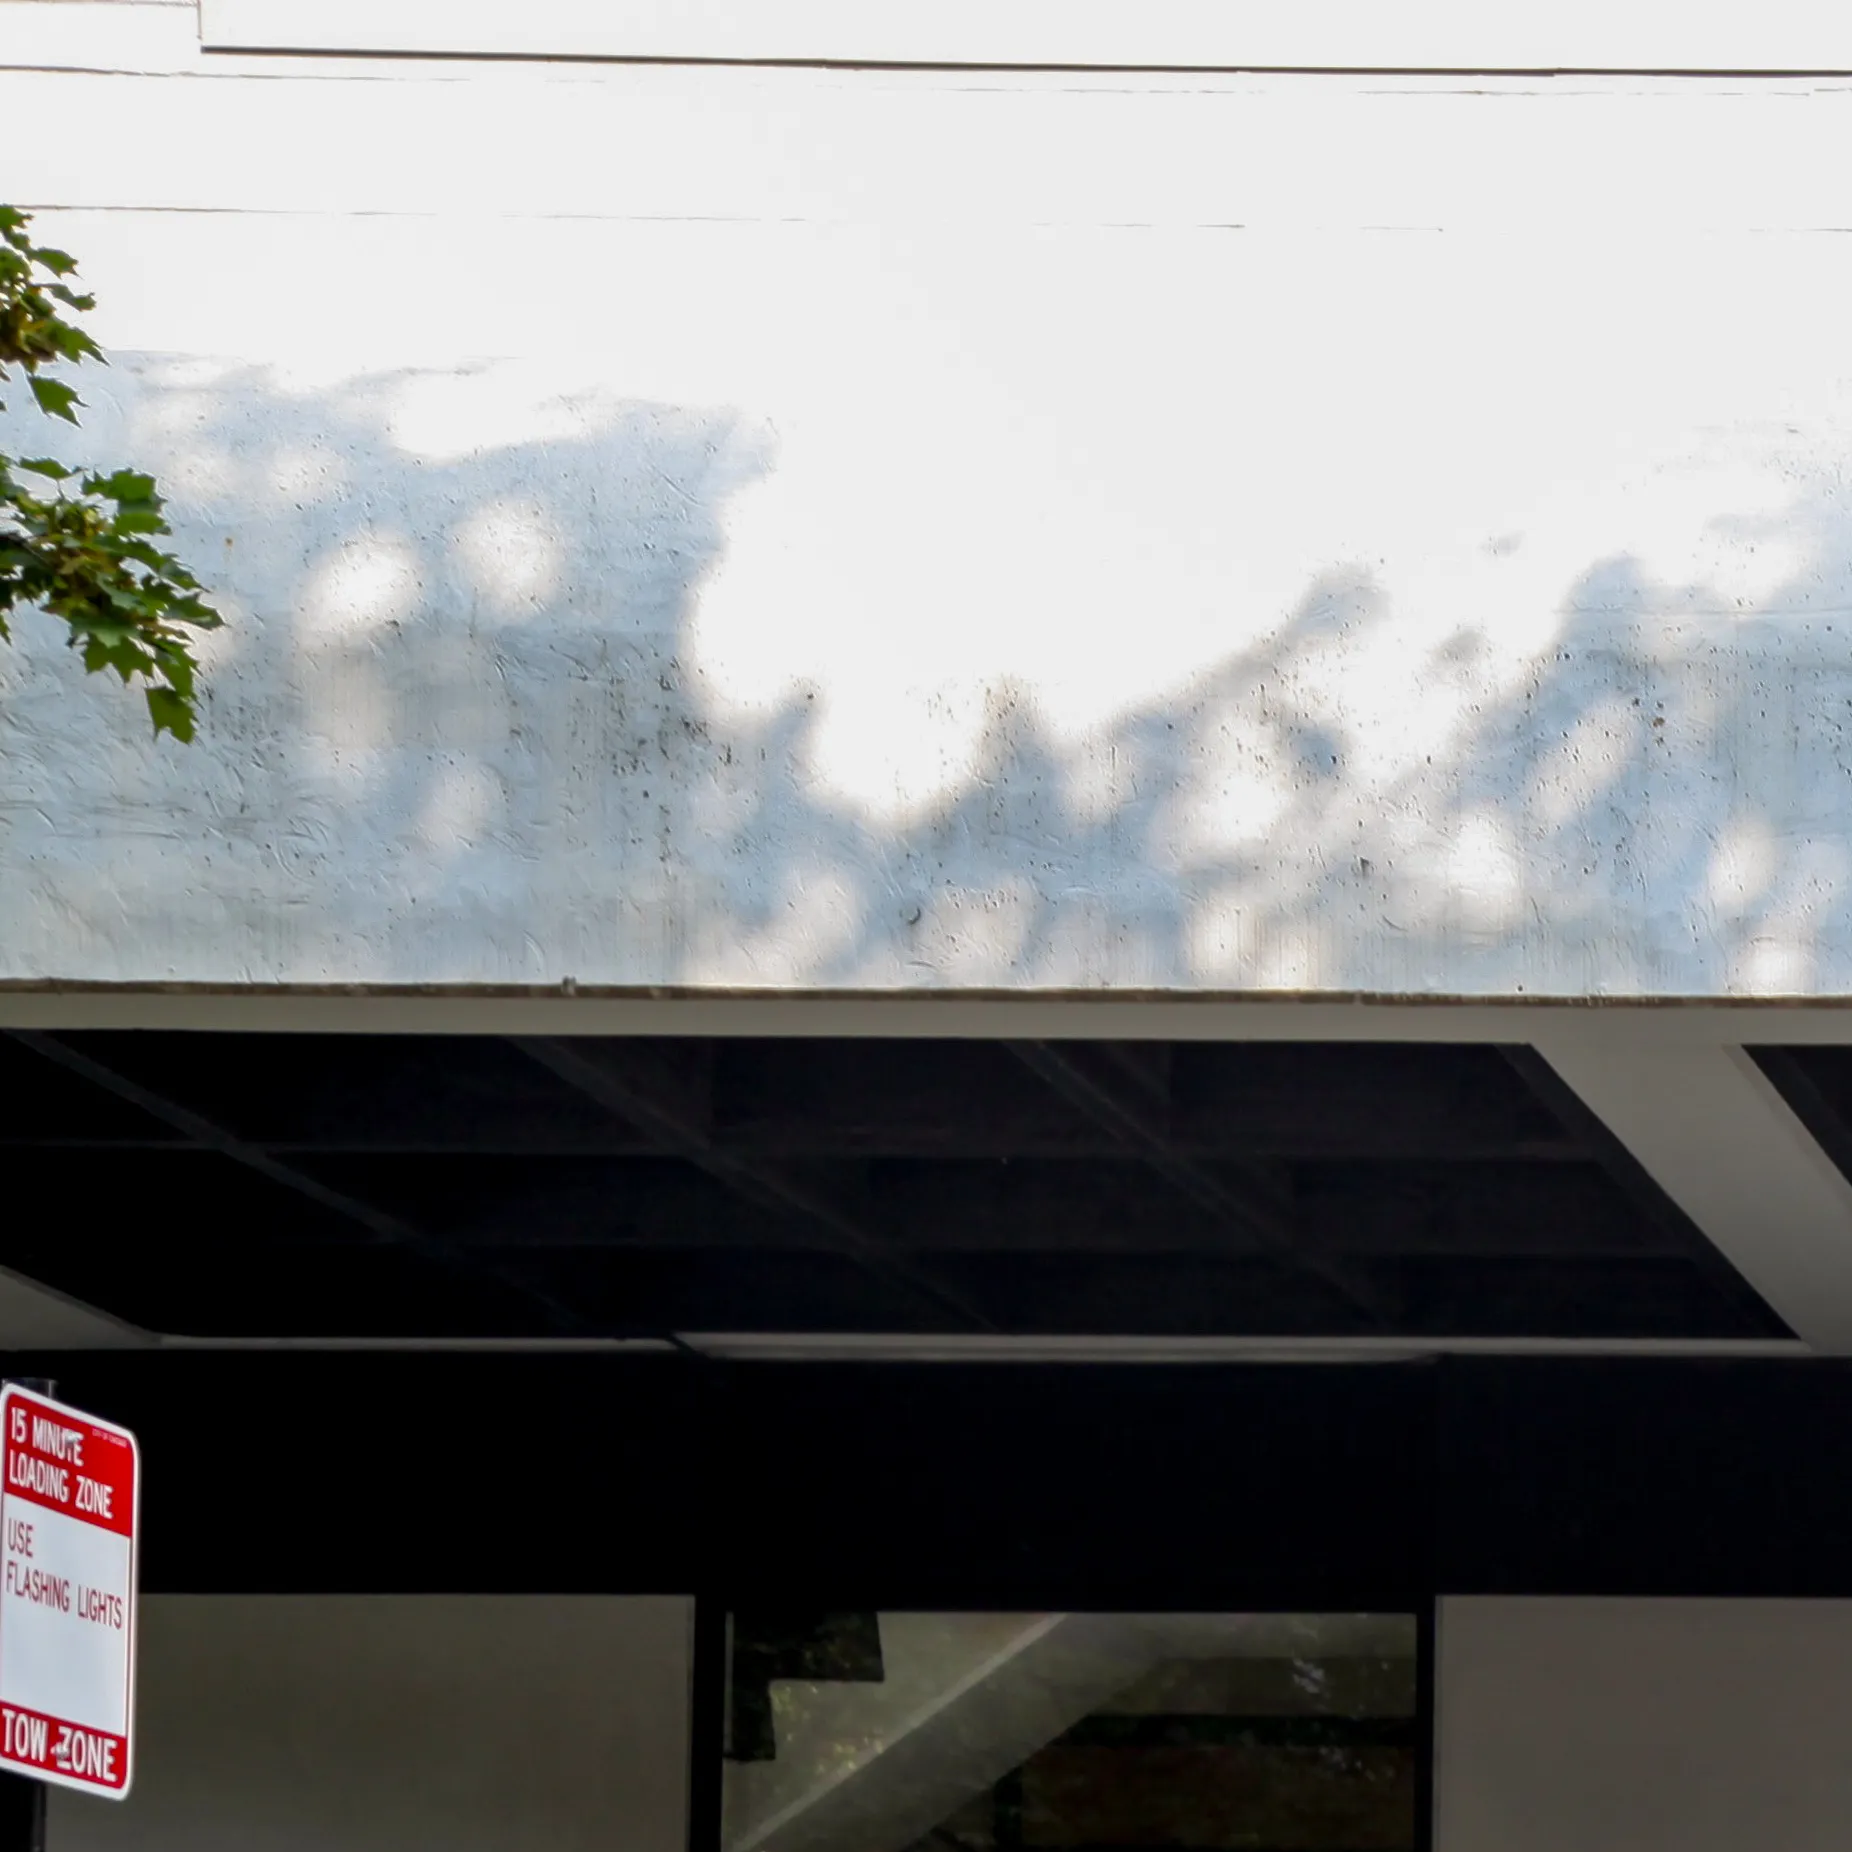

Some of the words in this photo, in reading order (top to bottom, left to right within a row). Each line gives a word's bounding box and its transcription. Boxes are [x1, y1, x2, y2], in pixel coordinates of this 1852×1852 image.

[11, 1407, 27, 1443] 15
[9, 1449, 70, 1503] LOADING
[75, 1475, 113, 1519] ZONE
[7, 1517, 33, 1558] USE
[6, 1560, 70, 1613] FLASHING
[77, 1584, 122, 1629] LIGHTS
[2, 1708, 48, 1762] TOW
[57, 1726, 117, 1782] ZONE
